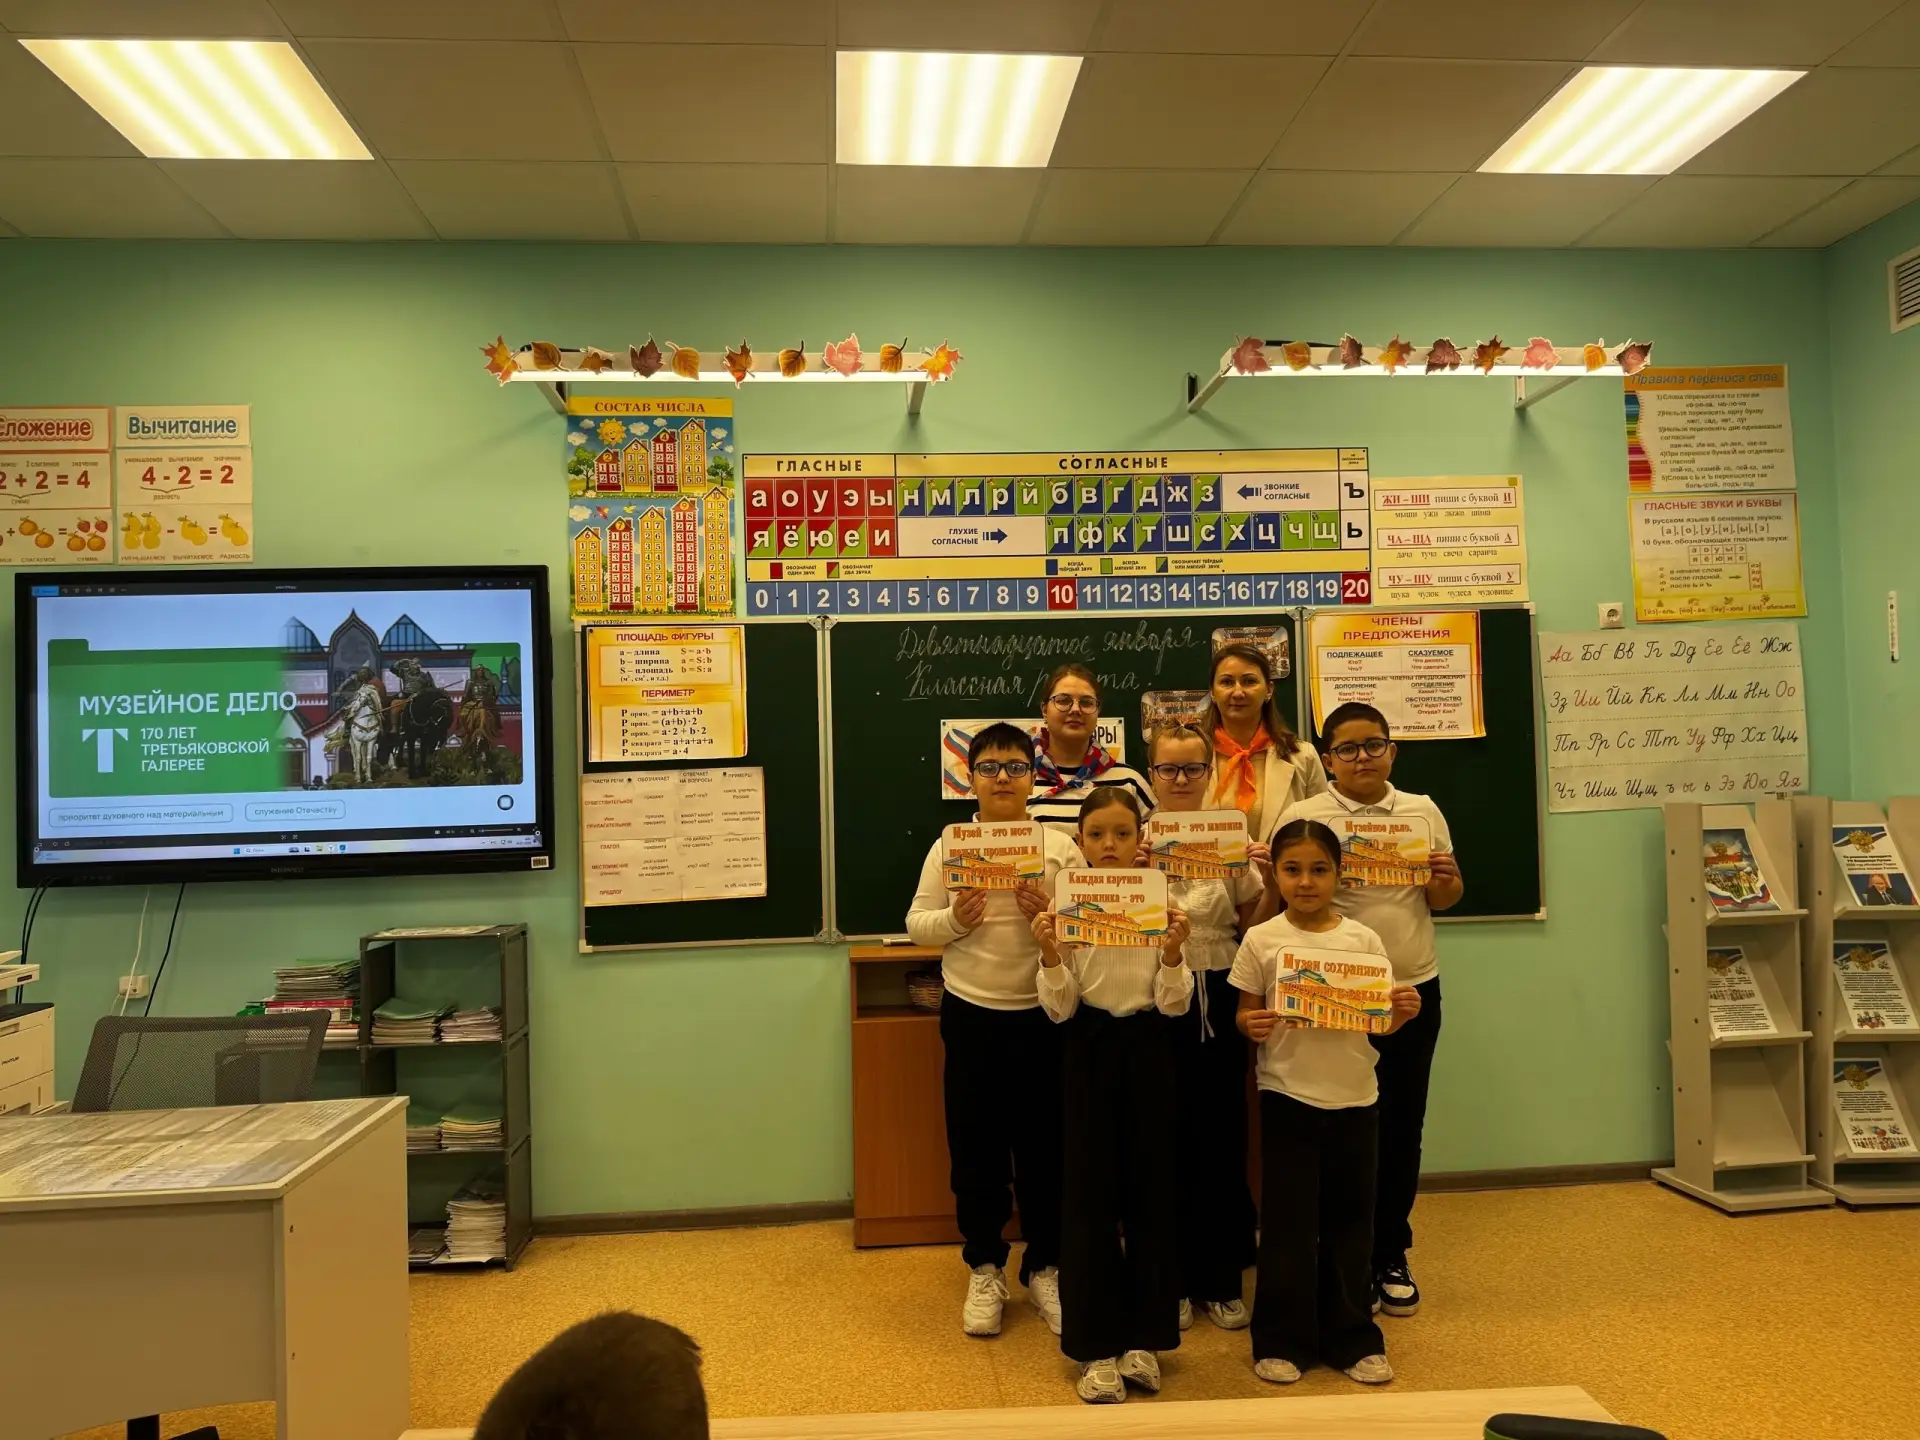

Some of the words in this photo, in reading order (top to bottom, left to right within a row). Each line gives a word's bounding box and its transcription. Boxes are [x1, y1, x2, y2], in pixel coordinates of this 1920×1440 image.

[1631, 373, 1684, 385] Правила
[1749, 373, 1778, 382] слов
[595, 402, 651, 412] СОСТАВ
[656, 402, 705, 412] ЧИСЛА
[128, 416, 236, 435] Вычитание
[776, 460, 862, 472] ГЛАСНЫЕ
[1059, 457, 1169, 470] СОГЛАСНЫЕ
[15, 473, 27, 487] +
[35, 471, 49, 489] 2
[56, 474, 69, 486] =
[77, 470, 90, 488] 4
[142, 466, 156, 485] 4
[177, 466, 192, 484] 2
[199, 469, 213, 481] =
[220, 465, 234, 484] 2
[1264, 483, 1300, 491] ЗВОНКИЕ
[752, 489, 768, 507] а
[781, 489, 798, 507] о
[812, 489, 829, 513] у
[843, 489, 859, 506] э
[870, 489, 892, 506] ы
[904, 489, 919, 506] н
[932, 489, 950, 506] м
[963, 488, 980, 506] л
[992, 488, 1009, 511] р
[1025, 483, 1038, 505] й
[1051, 482, 1069, 504] б
[1081, 488, 1098, 504] в
[1113, 488, 1125, 503] г
[1139, 487, 1158, 507] д
[1167, 486, 1188, 503] ж
[1201, 485, 1215, 502] з
[1264, 491, 1310, 501] СОГЛАСНЫЕ
[1383, 494, 1400, 506] ЖИ
[1411, 494, 1430, 505] ШИ
[1435, 495, 1459, 503] пиши
[1468, 493, 1499, 504] буквой
[1503, 492, 1512, 503] И
[1644, 502, 1697, 511] ГЛАСНЫЕ
[1701, 501, 1733, 509] ЗВУКИ
[1746, 499, 1782, 508] БУКВЫ
[931, 537, 979, 546] СОГЛАСНЫЕ
[1387, 535, 1403, 546] ЧА
[1412, 534, 1431, 545] ЩА
[1469, 533, 1500, 544] буквой
[1504, 533, 1512, 543] А
[1468, 549, 1497, 557] саранча
[755, 589, 769, 609] 0
[787, 589, 798, 608] 1
[817, 588, 830, 608] 2
[847, 588, 860, 608] 3
[877, 587, 890, 607] 4
[907, 587, 920, 607] 5
[937, 586, 950, 605] 6
[966, 586, 980, 605] 7
[997, 586, 1010, 605] 8
[1026, 585, 1039, 604] 9
[1051, 584, 1074, 604] 10
[1082, 584, 1101, 603] 11
[1110, 583, 1133, 603] 12
[1139, 582, 1162, 602] 13
[1168, 582, 1191, 602] 14
[1198, 582, 1221, 601] 15
[1227, 581, 1250, 600] 16
[1257, 580, 1280, 599] 17
[1286, 580, 1309, 599] 18
[1316, 579, 1337, 598] 19
[1344, 579, 1369, 598] 20
[1372, 617, 1422, 626] ЧЛЕНЫ
[616, 633, 668, 641] ПЛОЩАДЬ
[671, 632, 714, 641] ФИГУРЫ
[1344, 630, 1450, 641] ПРЕДЛОЖЕНИЯ
[1103, 620, 1206, 674] января.
[1547, 645, 1573, 663] Аа
[1581, 643, 1608, 661] Бб
[1613, 642, 1635, 660] Вв
[1644, 640, 1663, 658] Гг
[1670, 640, 1697, 663] Дд
[1704, 638, 1723, 656] Ее
[1732, 635, 1751, 654] Ёё
[1760, 636, 1793, 654] Жж
[1327, 651, 1383, 659] ПОДЛЕЖАЩЕЕ
[641, 689, 695, 698] ПЕРИМЕТР
[1027, 665, 1153, 708] рта.
[79, 688, 220, 716] МУЗЕЙНОЕ
[226, 691, 297, 716] ДЕЛО
[141, 727, 164, 740] 170
[167, 726, 197, 739] ЛЕТ
[141, 738, 270, 756] ТРЕТЬЯКОВСКОЙ
[141, 758, 205, 772] ГАЛЕРЕЕ
[58, 814, 101, 823] приоритет
[102, 811, 144, 822] духовного
[146, 811, 161, 819] над
[163, 809, 224, 819] материальным
[254, 807, 294, 817] служение
[296, 806, 337, 817] Отечеству
[952, 826, 982, 841] Музей
[992, 828, 1007, 837] это
[1011, 827, 1032, 836] мост
[1152, 821, 1179, 836] Музей
[1190, 823, 1205, 832] это
[1207, 821, 1243, 832] машина
[1345, 821, 1387, 835] Музейное
[1389, 823, 1412, 834] дело.
[1068, 872, 1104, 886] Каждая
[1106, 874, 1143, 888] картина
[1071, 893, 1120, 904] художника
[1130, 894, 1145, 903] это
[1283, 953, 1321, 972] Музеи
[1324, 961, 1387, 979] сохраняют
